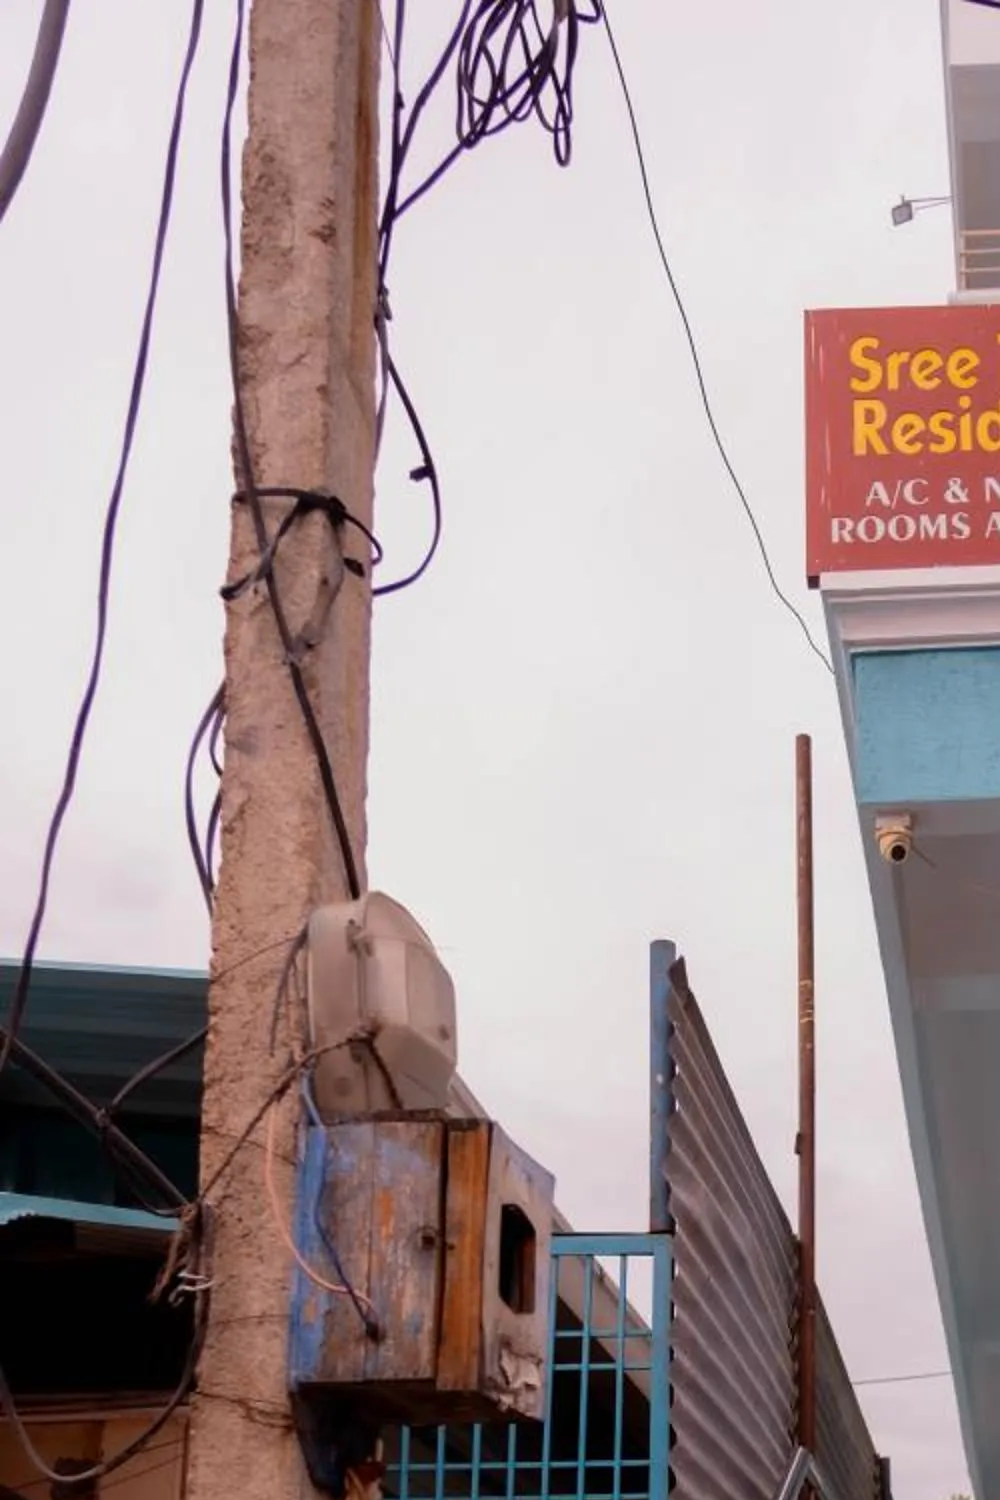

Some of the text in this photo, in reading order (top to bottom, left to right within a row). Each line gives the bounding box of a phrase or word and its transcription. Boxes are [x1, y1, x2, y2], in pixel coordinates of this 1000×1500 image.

[849, 336, 980, 392] Sree
[865, 478, 929, 509] A/C
[943, 478, 969, 503] &
[830, 512, 971, 543] ROOMS
